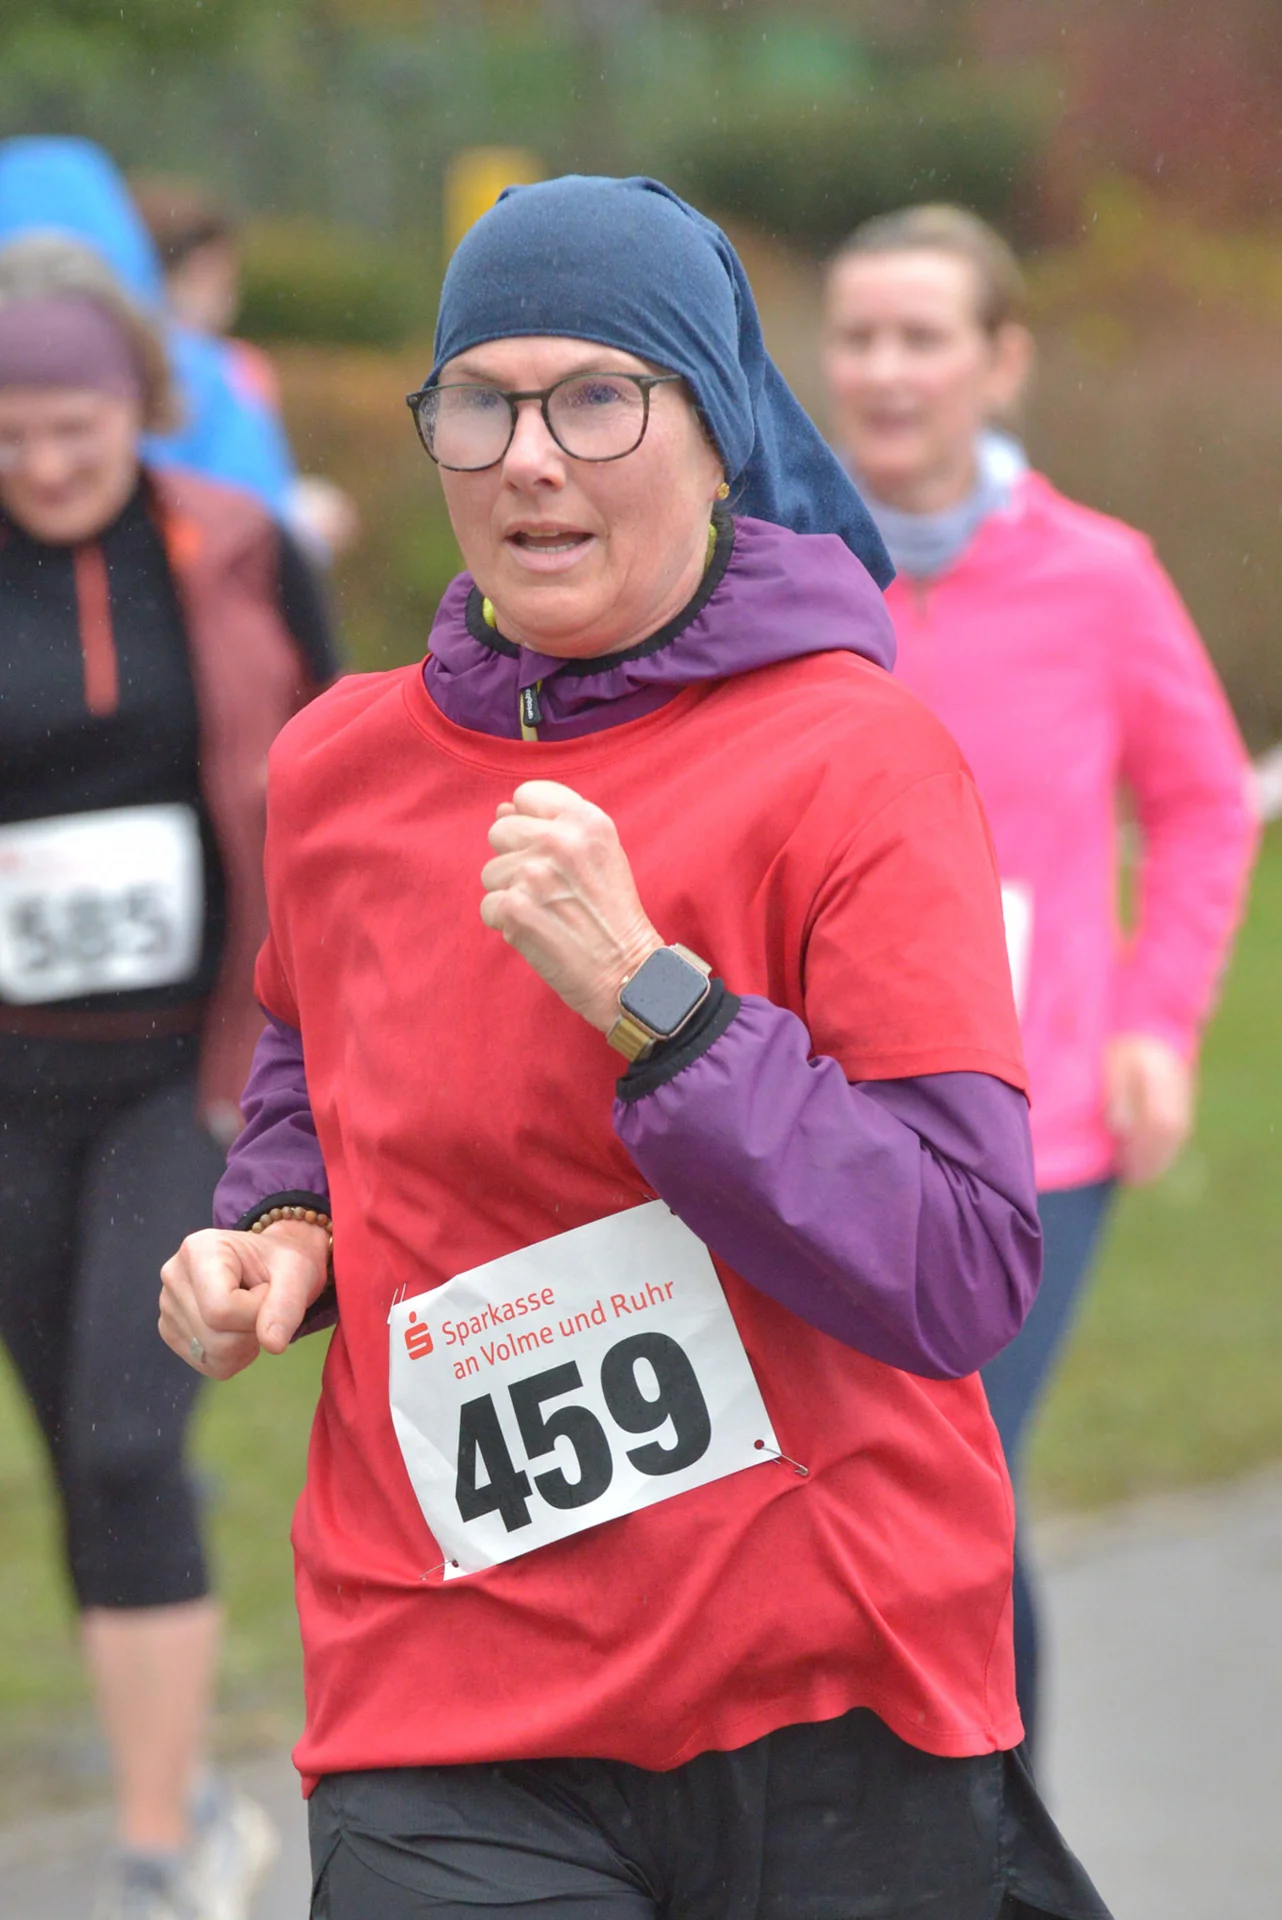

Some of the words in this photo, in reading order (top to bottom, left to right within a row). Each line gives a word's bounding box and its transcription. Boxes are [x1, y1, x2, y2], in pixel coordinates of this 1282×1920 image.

[442, 1287, 555, 1346] Sparkasse
[454, 1356, 479, 1380] an
[480, 1326, 553, 1366] Volme
[559, 1299, 606, 1337] und
[610, 1279, 675, 1318] Ruhr
[455, 1332, 711, 1533] 459
